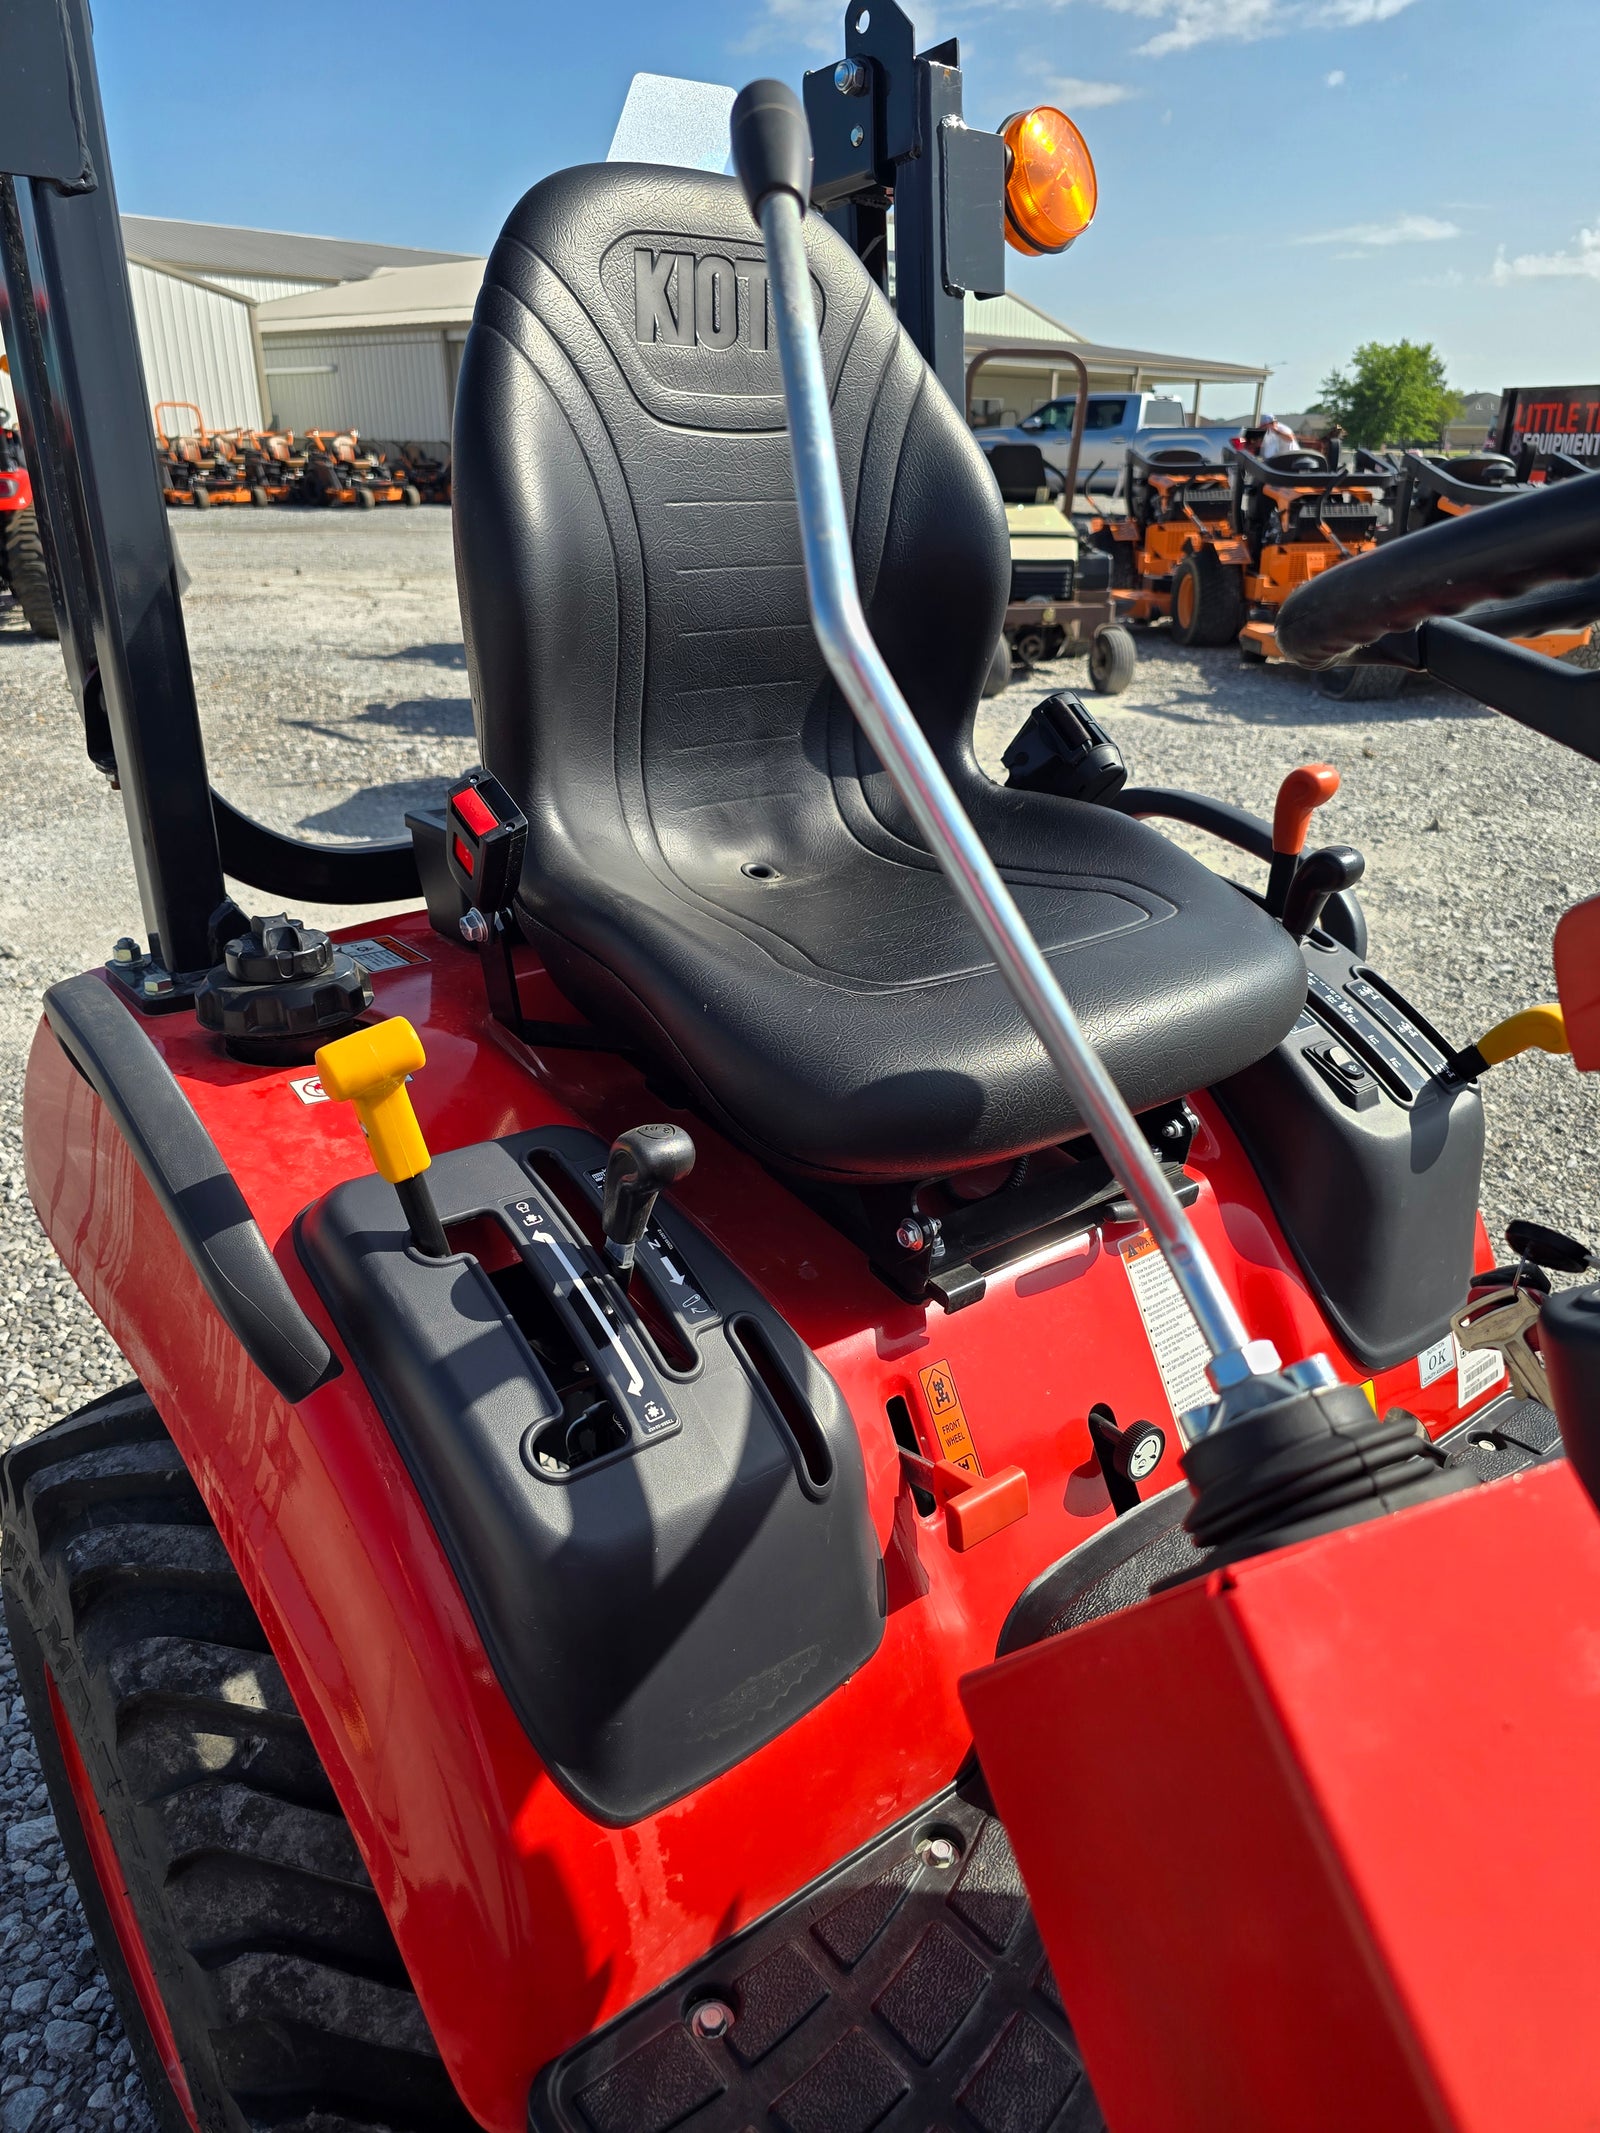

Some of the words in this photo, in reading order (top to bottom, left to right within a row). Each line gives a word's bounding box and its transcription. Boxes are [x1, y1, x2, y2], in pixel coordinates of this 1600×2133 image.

[634, 247, 770, 353] KIOT
[1514, 402, 1581, 433] LITTLE
[1586, 402, 1600, 432] T
[1428, 1347, 1447, 1370] OK
[941, 1419, 961, 1435] FRONT
[944, 1432, 966, 1448] WHEEL
